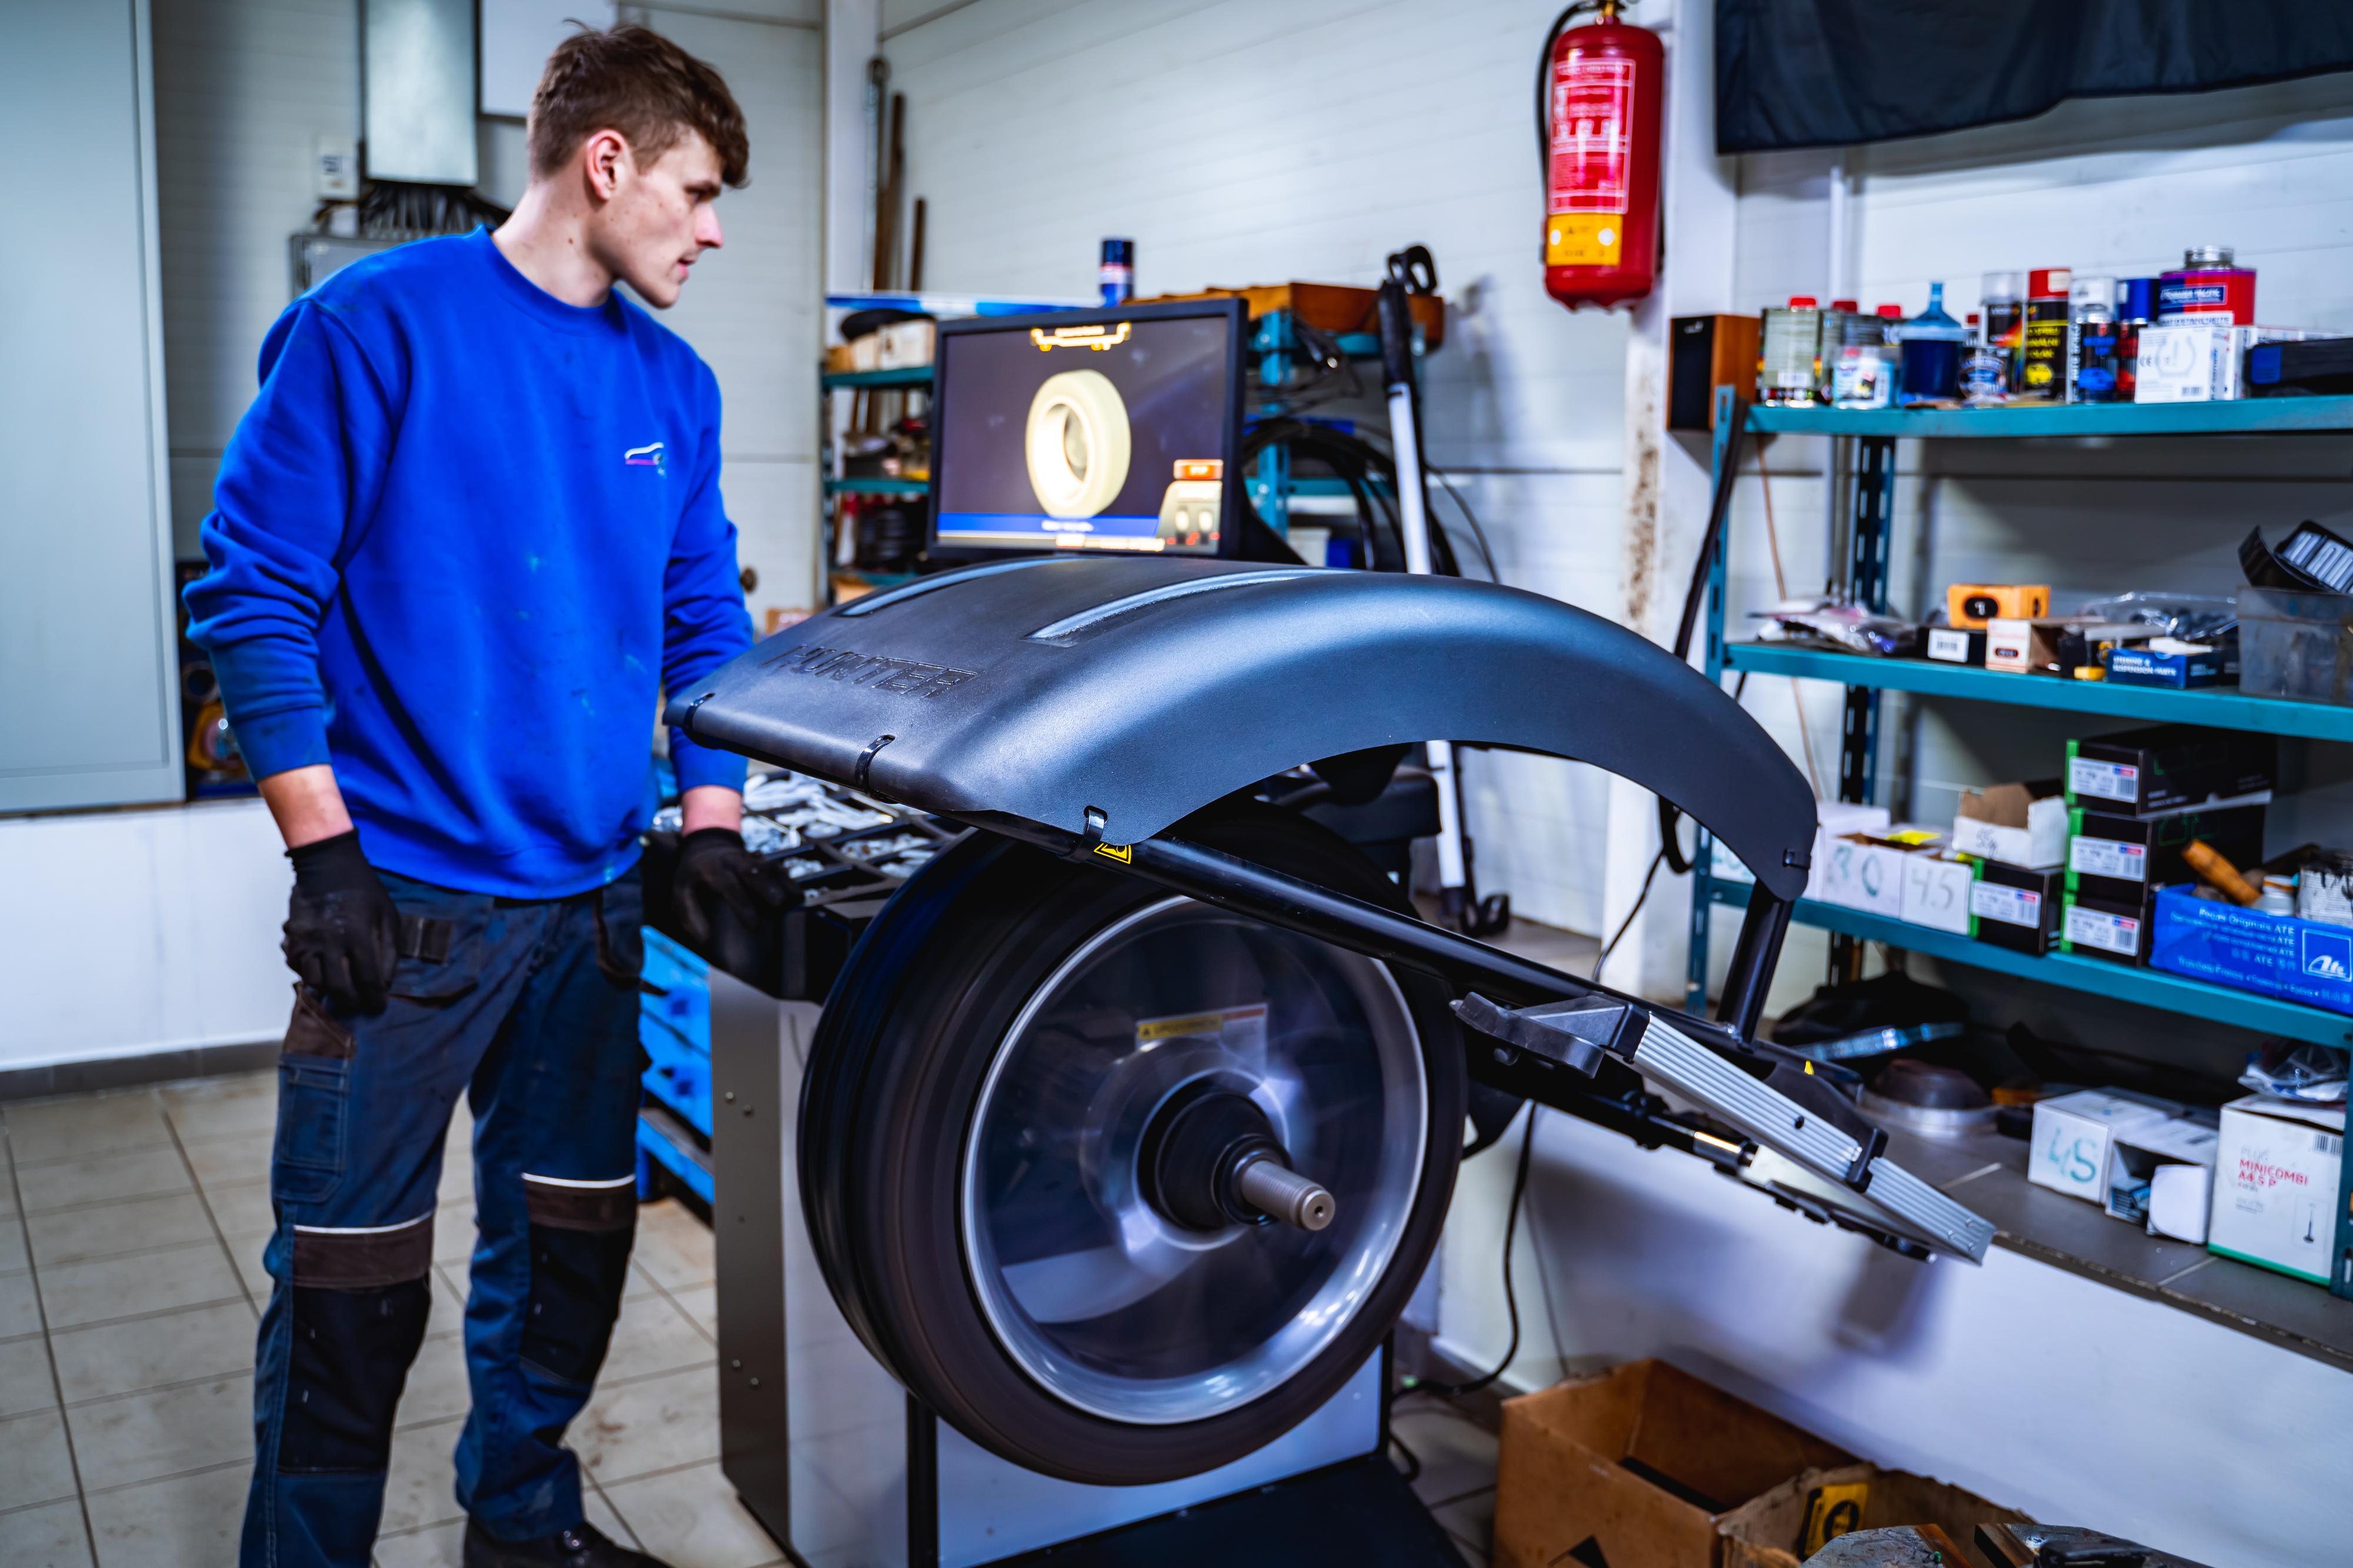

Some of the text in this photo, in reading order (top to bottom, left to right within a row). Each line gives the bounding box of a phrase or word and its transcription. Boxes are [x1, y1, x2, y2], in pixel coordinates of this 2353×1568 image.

[2275, 925, 2295, 936] ATE
[2277, 936, 2295, 947] ATE
[2278, 947, 2295, 957] ATE
[2254, 955, 2274, 967] ATE
[2239, 1157, 2309, 1186] MINICOMBI
